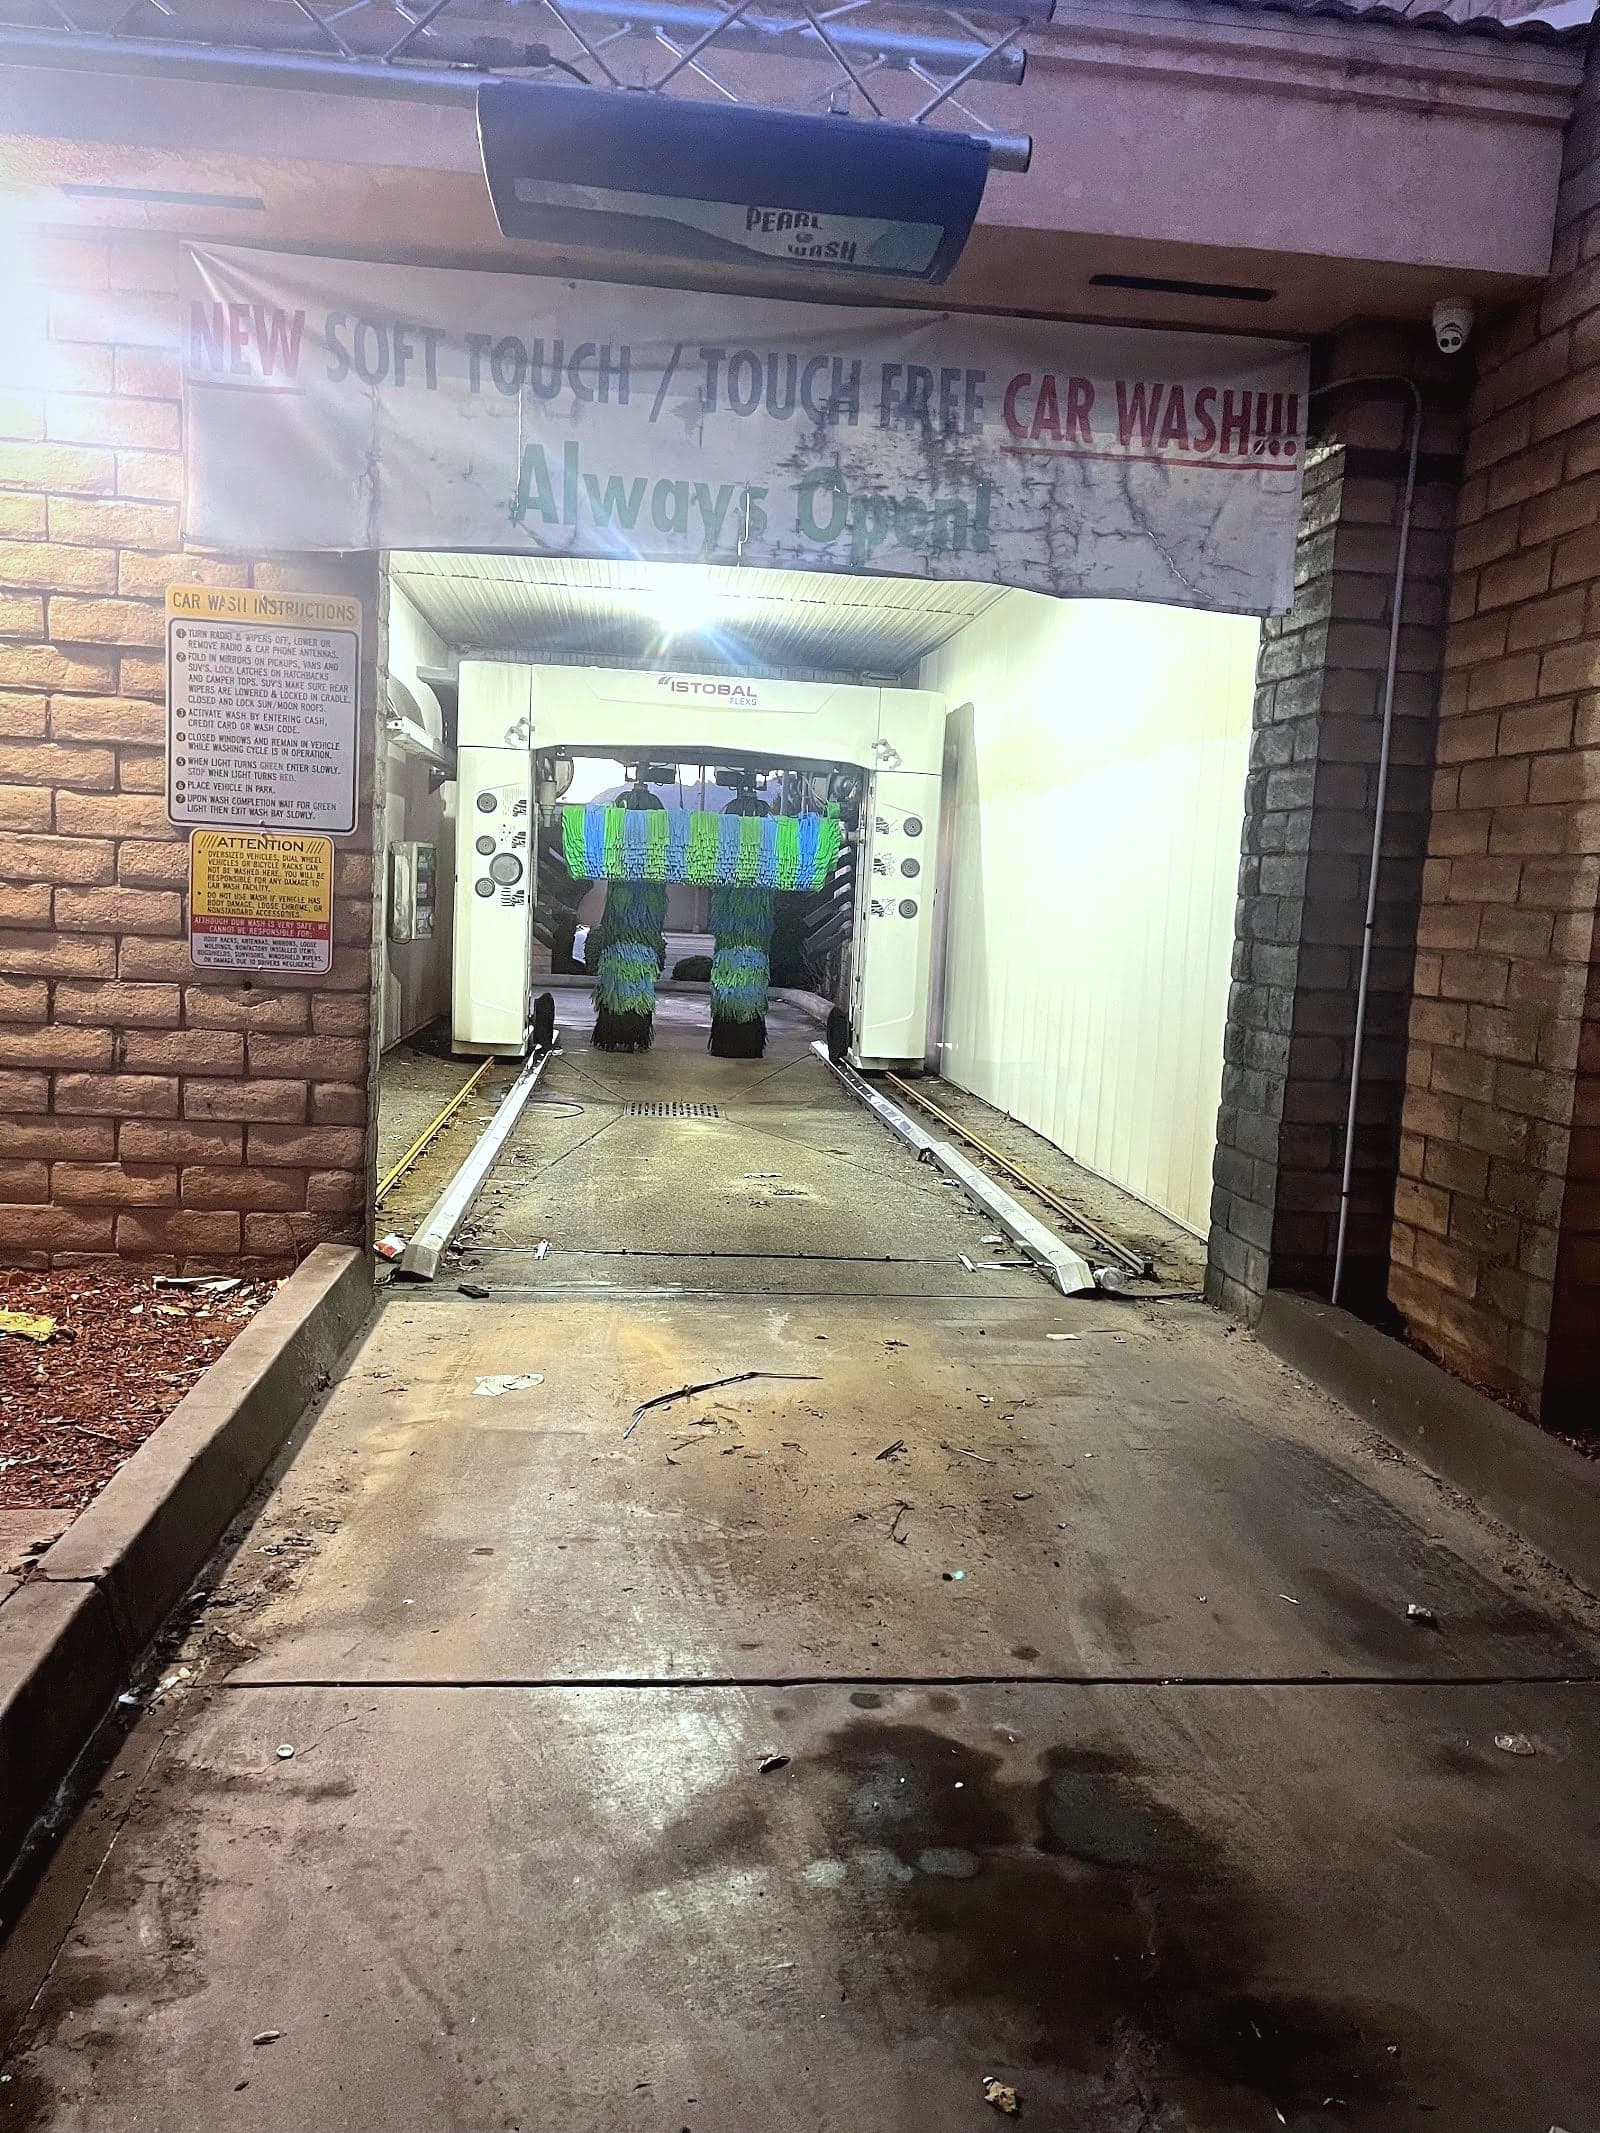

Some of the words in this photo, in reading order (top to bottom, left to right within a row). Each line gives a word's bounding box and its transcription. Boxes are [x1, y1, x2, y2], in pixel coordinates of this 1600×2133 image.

[745, 206, 822, 232] PEARL
[787, 240, 857, 262] WASH
[190, 301, 305, 377] NEW
[320, 310, 446, 391] SOFT
[464, 332, 632, 405] TOUCH
[648, 343, 683, 423] /
[701, 348, 861, 426] TOUCH
[880, 363, 986, 435] FREE
[1002, 373, 1096, 444] CAR
[1115, 380, 1298, 457] WASH!!!
[517, 440, 768, 553] Always
[800, 465, 991, 566] Open!
[173, 591, 201, 609] CAR
[207, 594, 247, 613] WASH
[254, 597, 355, 621] INSTRUCTIONS
[188, 628, 208, 639] TURN
[210, 630, 233, 641] RADIO
[293, 636, 318, 648] LOWER
[321, 638, 331, 649] OR
[188, 640, 218, 651] REMOVE
[220, 642, 242, 652] RADIO
[245, 644, 252, 653] &
[255, 645, 270, 654] CAR
[272, 646, 297, 656] PHONE
[188, 652, 207, 662] FOLD
[209, 654, 217, 663] IN
[219, 654, 252, 665] MIRRORS
[254, 657, 265, 666] ON
[302, 660, 321, 670] VANS
[323, 662, 339, 672] AND
[214, 664, 234, 675] LOCK
[236, 666, 268, 677] LATCHES
[270, 668, 281, 678] ON
[283, 669, 329, 681] HATCHBACKS
[188, 673, 203, 683] AND
[206, 675, 235, 685] CAMPER
[285, 680, 305, 691] MAKE
[307, 682, 328, 692] SURE
[329, 683, 349, 694] REAR
[671, 681, 758, 698] ISTOBAL
[188, 684, 215, 695] WIPERS
[217, 686, 232, 696] ARE
[234, 687, 269, 699] LOWERED
[271, 690, 277, 699] &
[280, 691, 308, 701] LOCKED
[310, 693, 318, 702] IN
[188, 695, 216, 705] CLOSED
[218, 697, 234, 707] AND
[236, 698, 255, 708] LOCK
[257, 700, 299, 711] SUN/MOON
[188, 708, 222, 719] ACTIVATE
[225, 711, 246, 721] WASH
[250, 712, 260, 722] BY
[263, 713, 301, 725] ENTERING
[188, 718, 214, 729] CREDIT
[217, 720, 237, 730] CARD
[240, 722, 251, 731] OR
[254, 723, 274, 733] WASH
[187, 732, 216, 743] CLOSED
[218, 734, 252, 745] WINDOWS
[253, 737, 269, 746] AND
[271, 738, 298, 748] REMAIN
[300, 740, 308, 749] IN
[310, 740, 340, 751] VEHICLE
[188, 741, 210, 752] WHILE
[212, 743, 244, 754] WASHING
[246, 745, 269, 756] CYCLE
[271, 747, 279, 756] IS
[281, 748, 289, 757] IN
[187, 756, 209, 766] WHEN
[211, 758, 231, 768] LIGHT
[234, 759, 257, 769] TURNS
[260, 761, 284, 771] GREEN
[286, 763, 309, 773] ENTER
[187, 767, 206, 777] STOP
[208, 768, 229, 778] WHEN
[231, 770, 251, 780] LIGHT
[254, 771, 277, 781] TURNS
[187, 780, 211, 790] PLACE
[212, 782, 243, 792] VEHICLE
[245, 784, 253, 793] IN
[187, 793, 207, 803] UPON
[209, 795, 229, 805] WASH
[231, 796, 276, 807] COMPLETION
[278, 799, 294, 809] WAIT
[296, 800, 311, 810] FOR
[312, 801, 337, 811] GREEN
[187, 804, 207, 814] LIGHT
[210, 805, 229, 815] THEN
[231, 807, 249, 816] EXIT
[248, 808, 268, 818] WASH
[270, 809, 284, 818] BAY
[216, 836, 304, 852] ATTENTION
